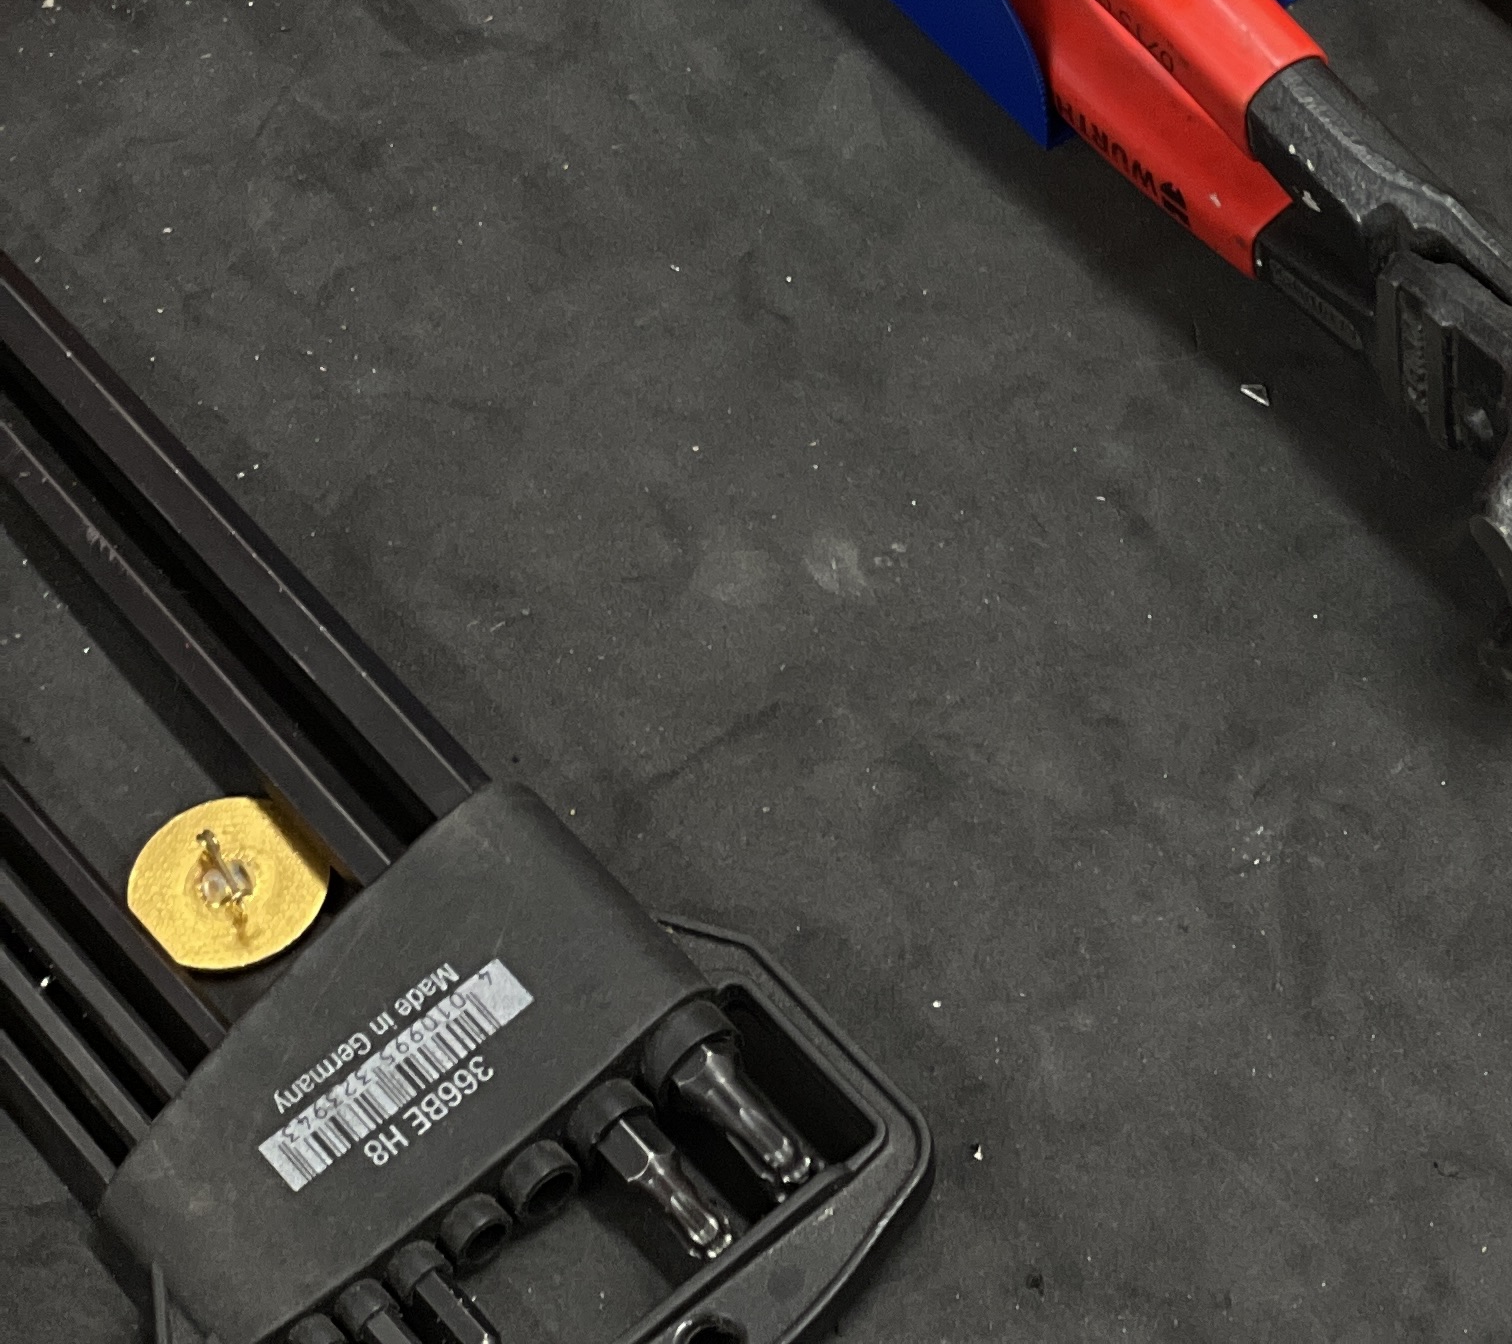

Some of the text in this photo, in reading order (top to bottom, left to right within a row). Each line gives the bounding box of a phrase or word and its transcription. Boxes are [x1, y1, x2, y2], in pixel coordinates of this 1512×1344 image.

[272, 962, 458, 1113] Made in Germany
[277, 969, 495, 1144] 4 010995 323943
[361, 1054, 495, 1168] 366BE H8
